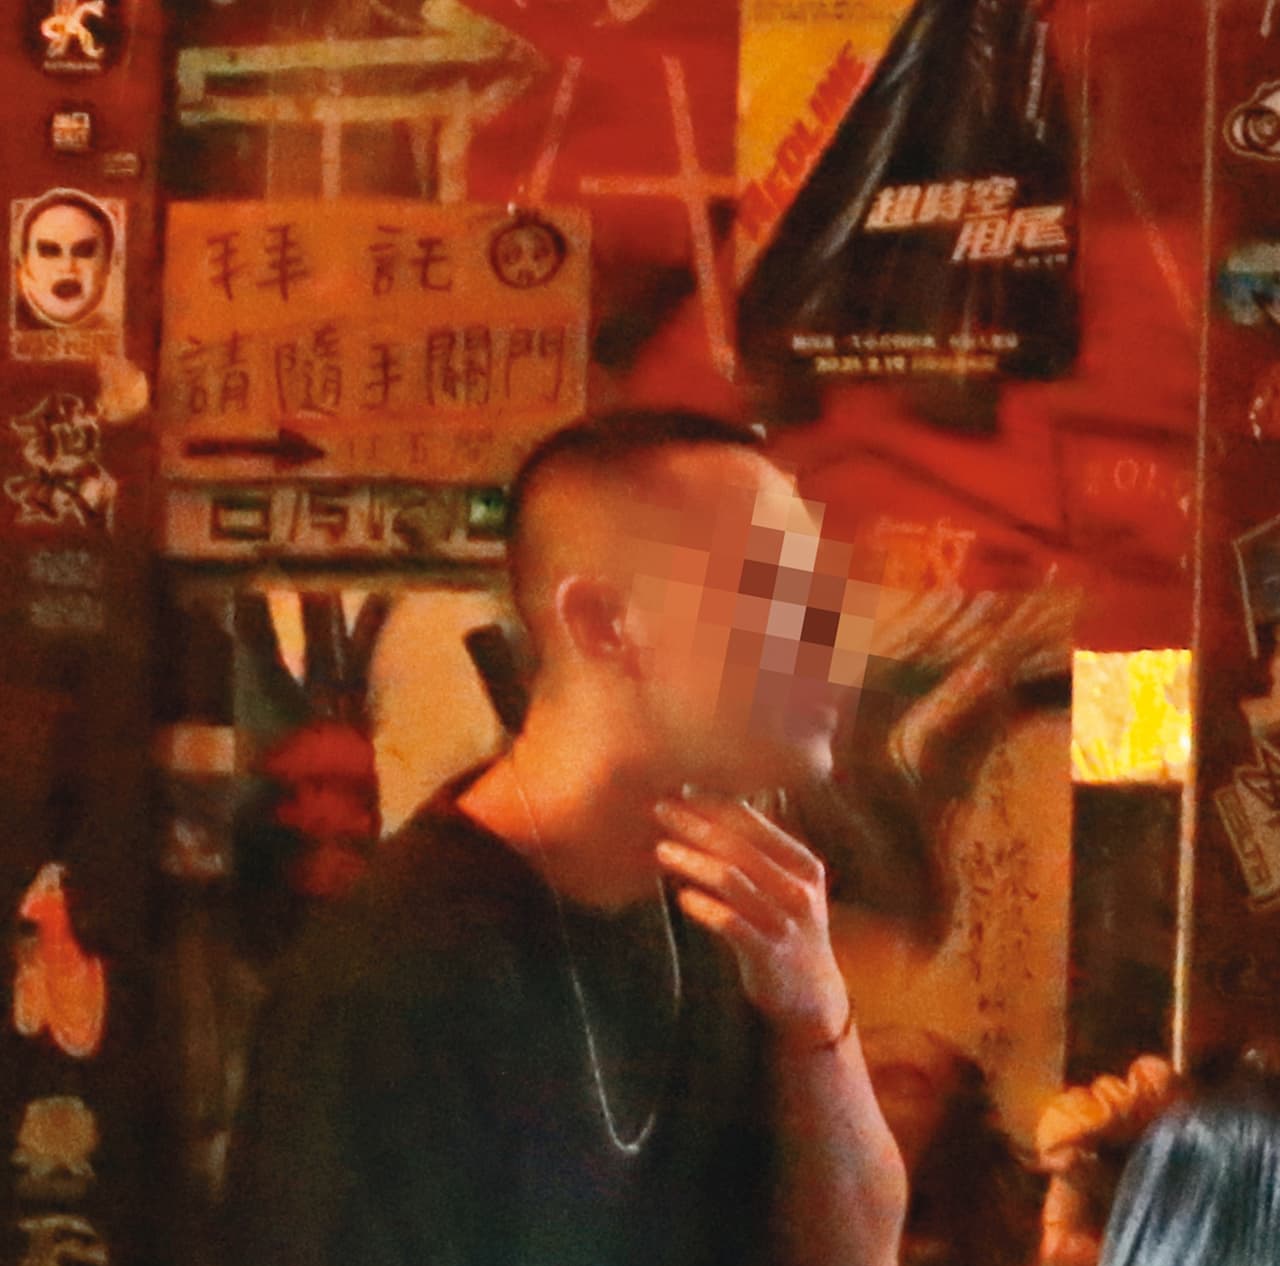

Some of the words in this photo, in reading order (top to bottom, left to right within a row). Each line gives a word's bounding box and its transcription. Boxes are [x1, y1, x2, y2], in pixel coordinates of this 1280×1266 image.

[179, 323, 567, 416] 請隨手關門
